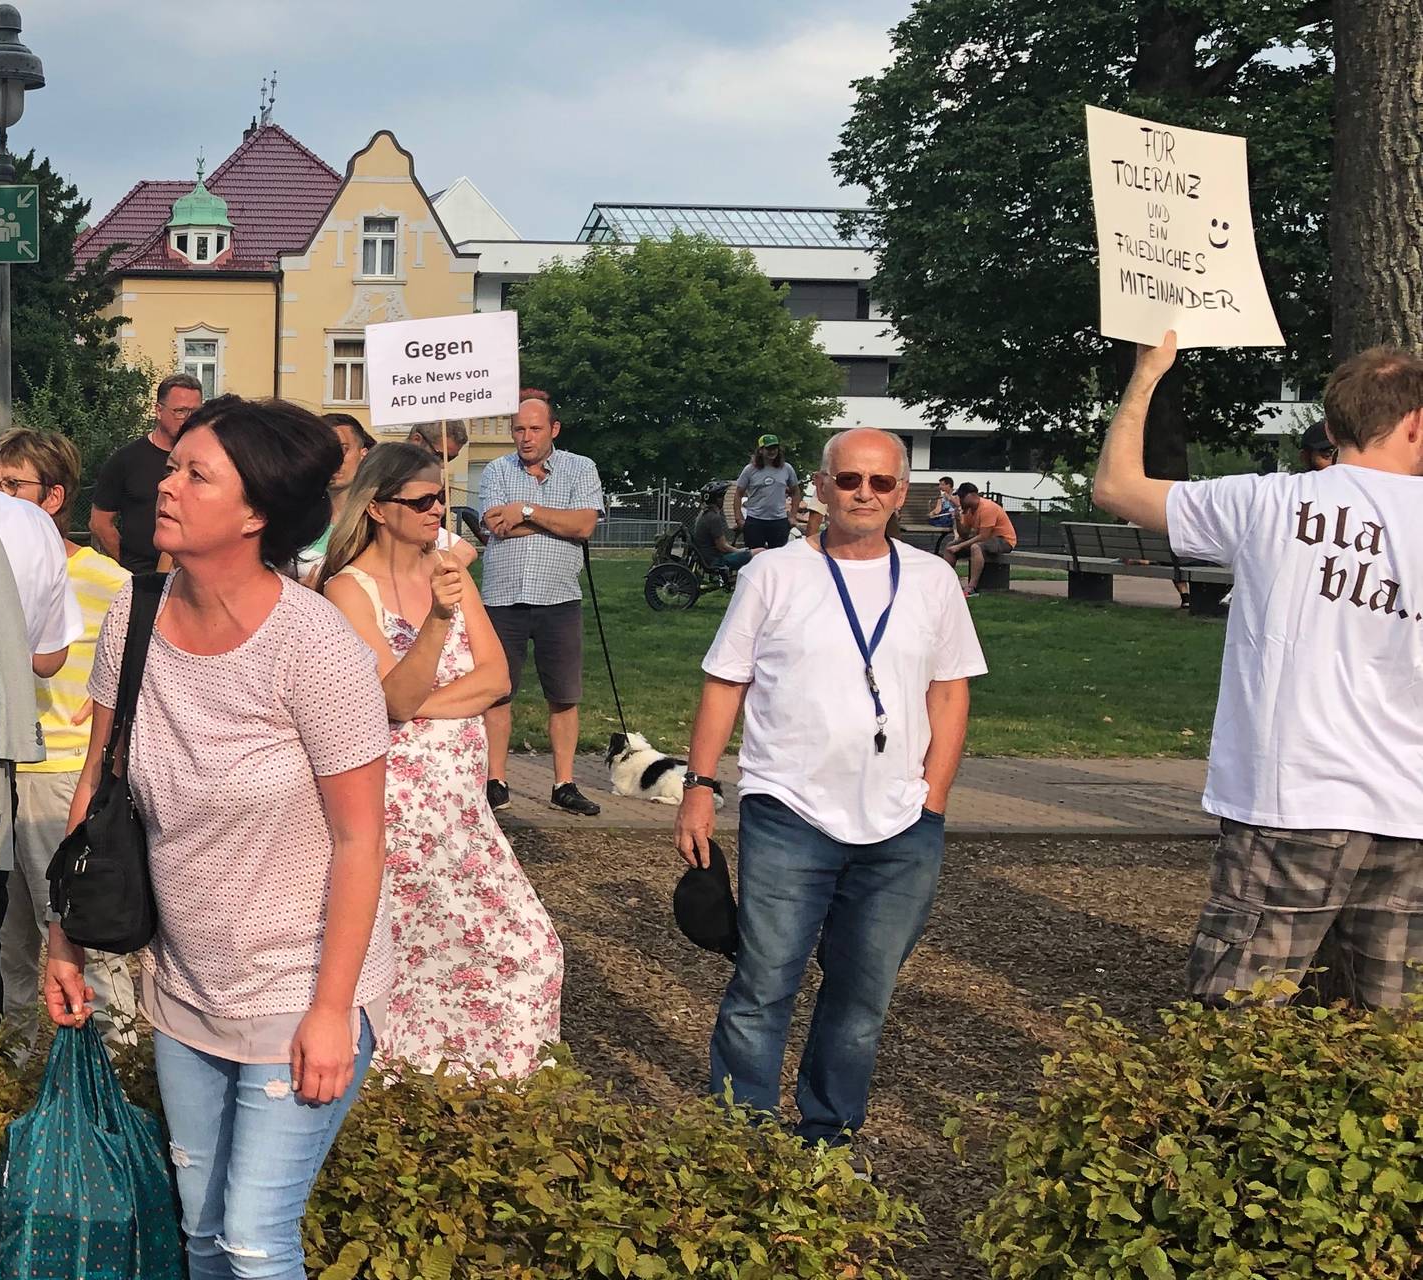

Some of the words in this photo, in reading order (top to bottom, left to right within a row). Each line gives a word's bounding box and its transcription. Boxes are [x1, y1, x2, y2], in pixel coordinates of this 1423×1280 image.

[1111, 160, 1201, 199] TOLERANZ
[1147, 202, 1170, 223] UND
[1149, 224, 1168, 241] EIN
[1114, 232, 1206, 275] FRIEDLICHES
[1120, 268, 1241, 313] MITEINANDER
[404, 340, 474, 361] Gegen
[392, 373, 422, 386] Fake
[426, 371, 462, 383] News
[465, 368, 489, 379] von
[391, 395, 417, 408] AFD
[421, 392, 446, 404] und
[450, 388, 492, 404] Pegida
[1295, 500, 1385, 556] bla
